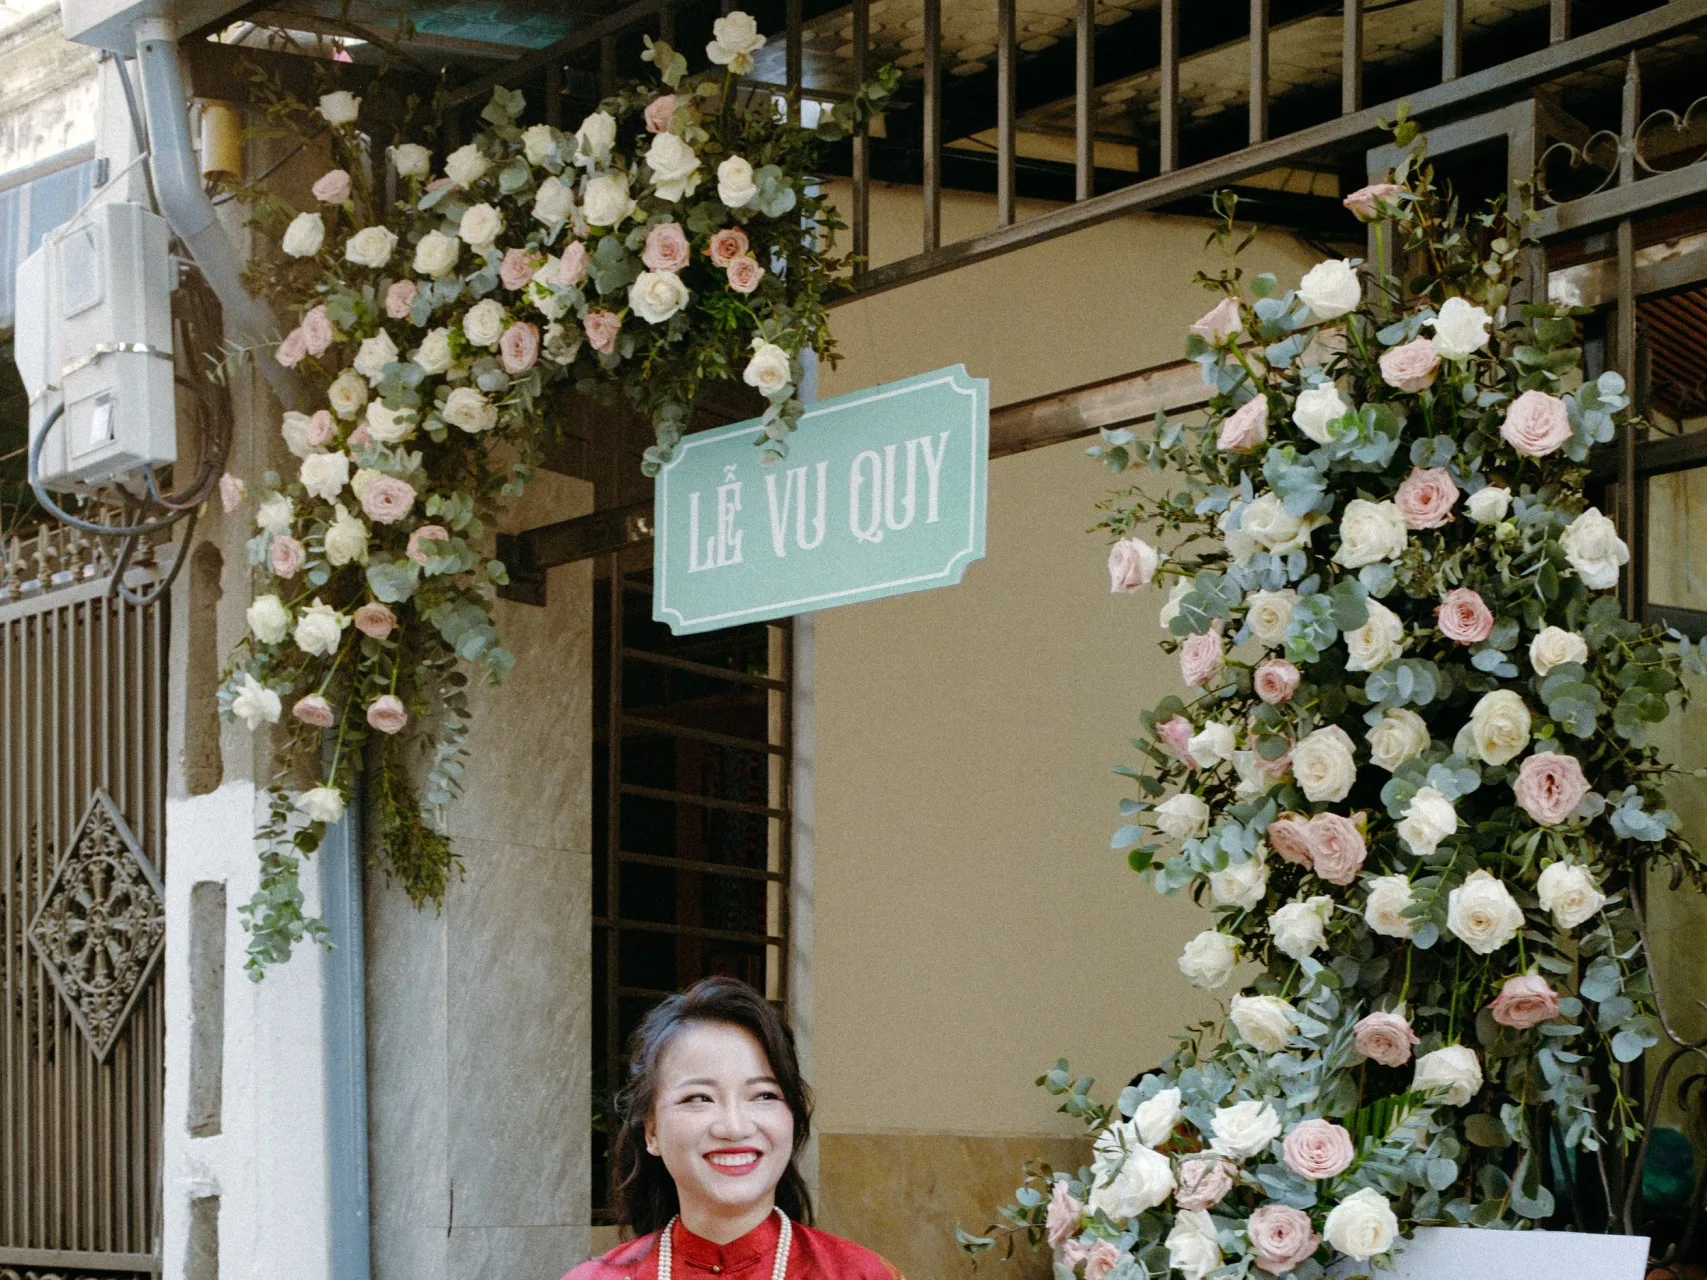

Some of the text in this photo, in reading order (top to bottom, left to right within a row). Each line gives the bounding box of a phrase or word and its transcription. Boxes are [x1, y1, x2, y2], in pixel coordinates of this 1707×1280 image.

[687, 431, 950, 573] LỄ VU QUY
